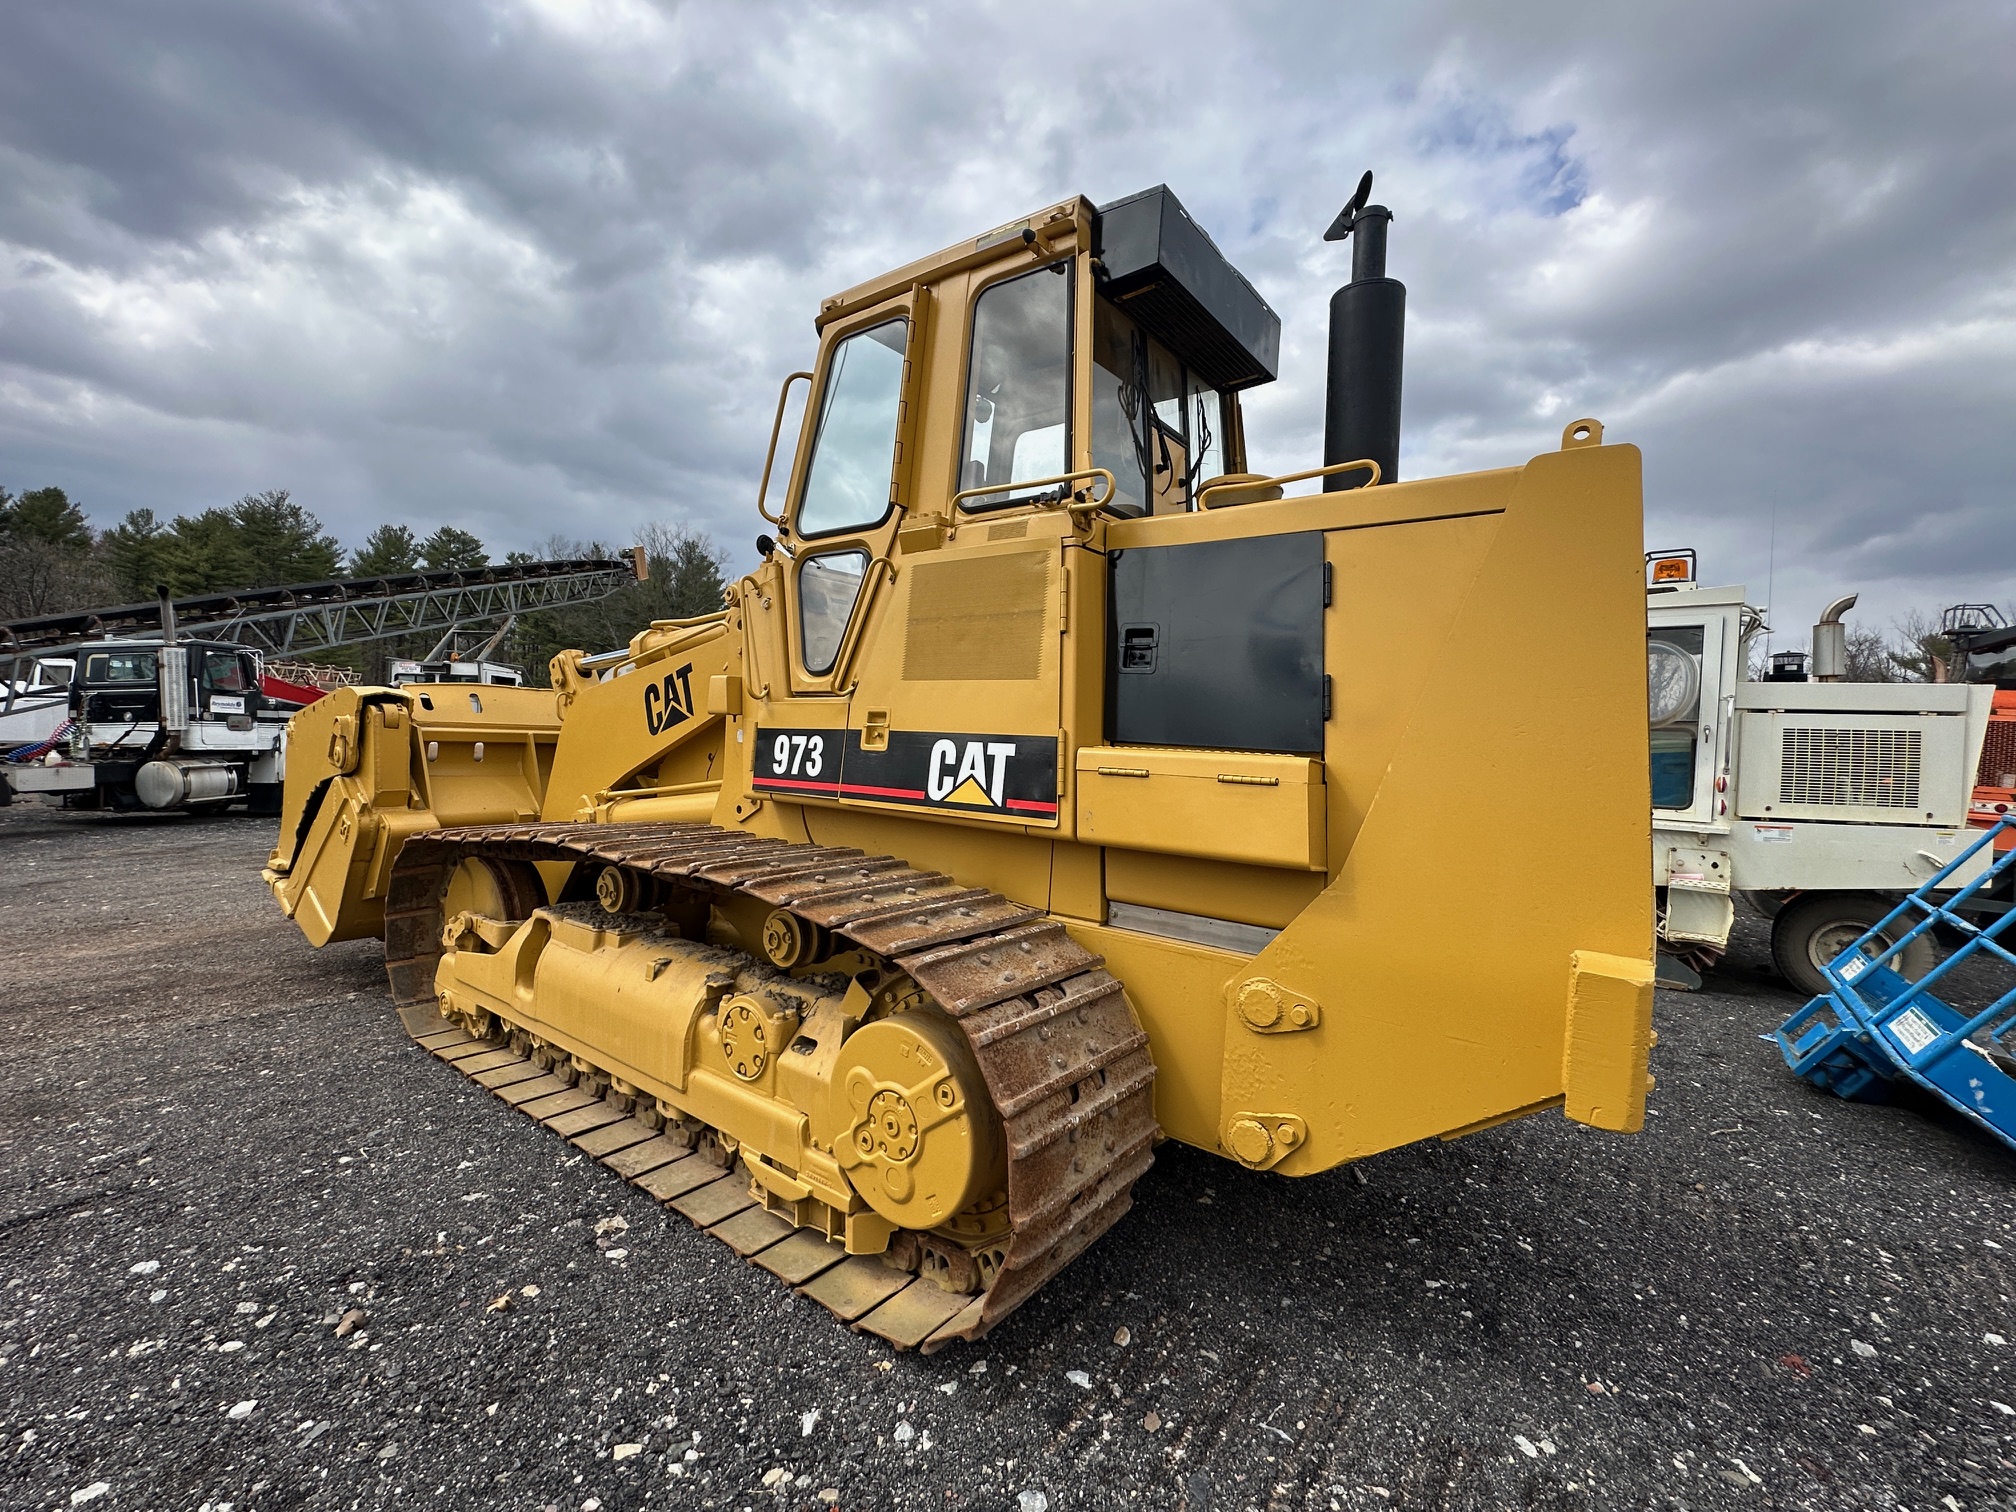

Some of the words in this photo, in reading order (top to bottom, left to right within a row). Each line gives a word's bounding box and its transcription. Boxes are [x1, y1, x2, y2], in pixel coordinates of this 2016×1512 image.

[644, 662, 695, 736] CAT
[772, 734, 824, 777] 973
[927, 738, 1017, 807] CAT
